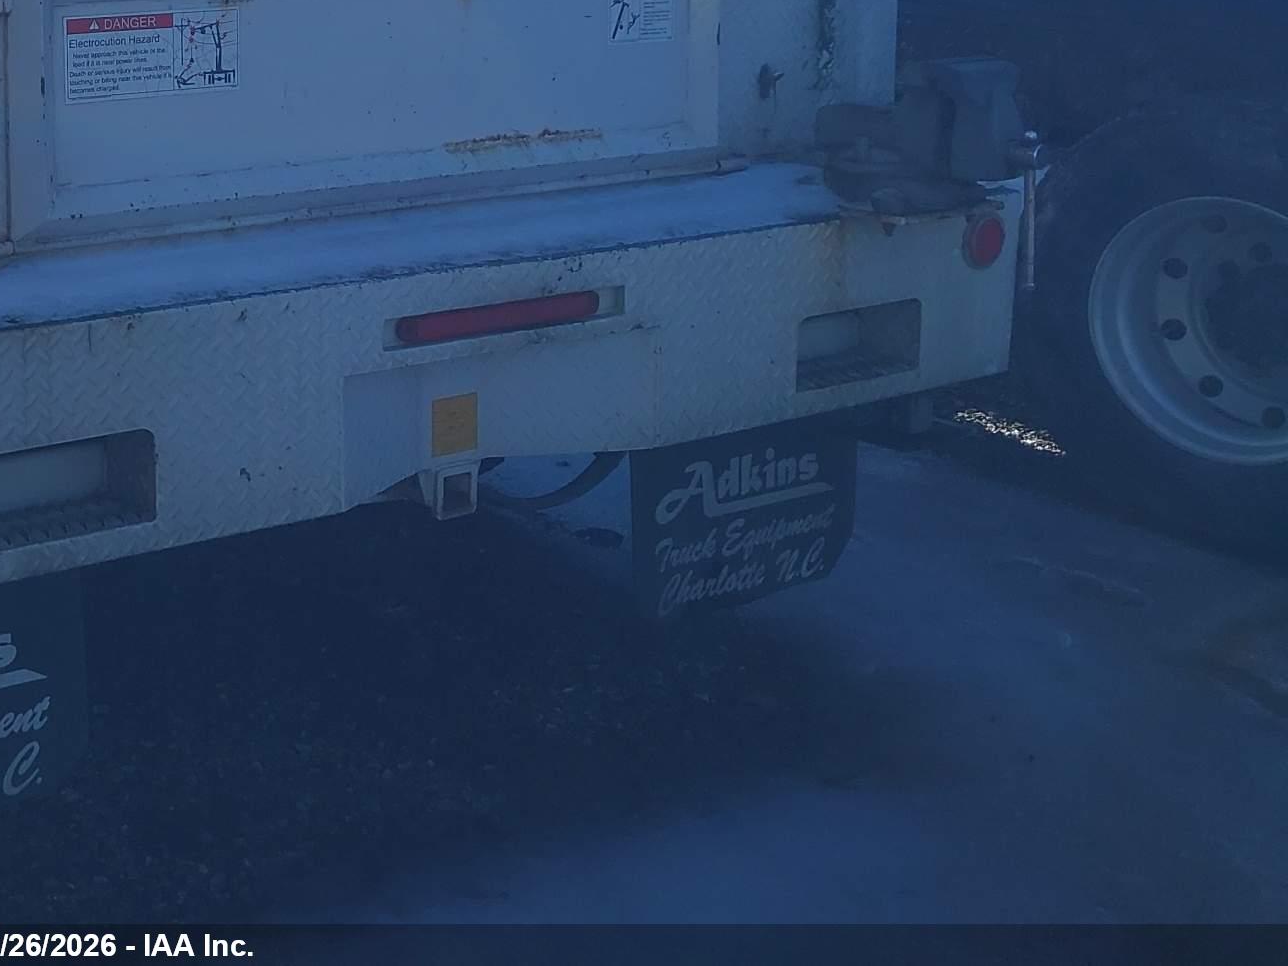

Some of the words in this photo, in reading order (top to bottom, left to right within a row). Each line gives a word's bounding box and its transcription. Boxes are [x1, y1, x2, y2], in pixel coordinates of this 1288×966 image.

[68, 36, 127, 49] Electrocution
[128, 34, 161, 45] Hazard
[104, 17, 156, 30] DANGER
[655, 447, 834, 524] Adkins
[655, 528, 718, 573] Truck
[721, 503, 836, 560] Equipment
[658, 561, 765, 617] Charlotte
[775, 537, 825, 583] N.C.
